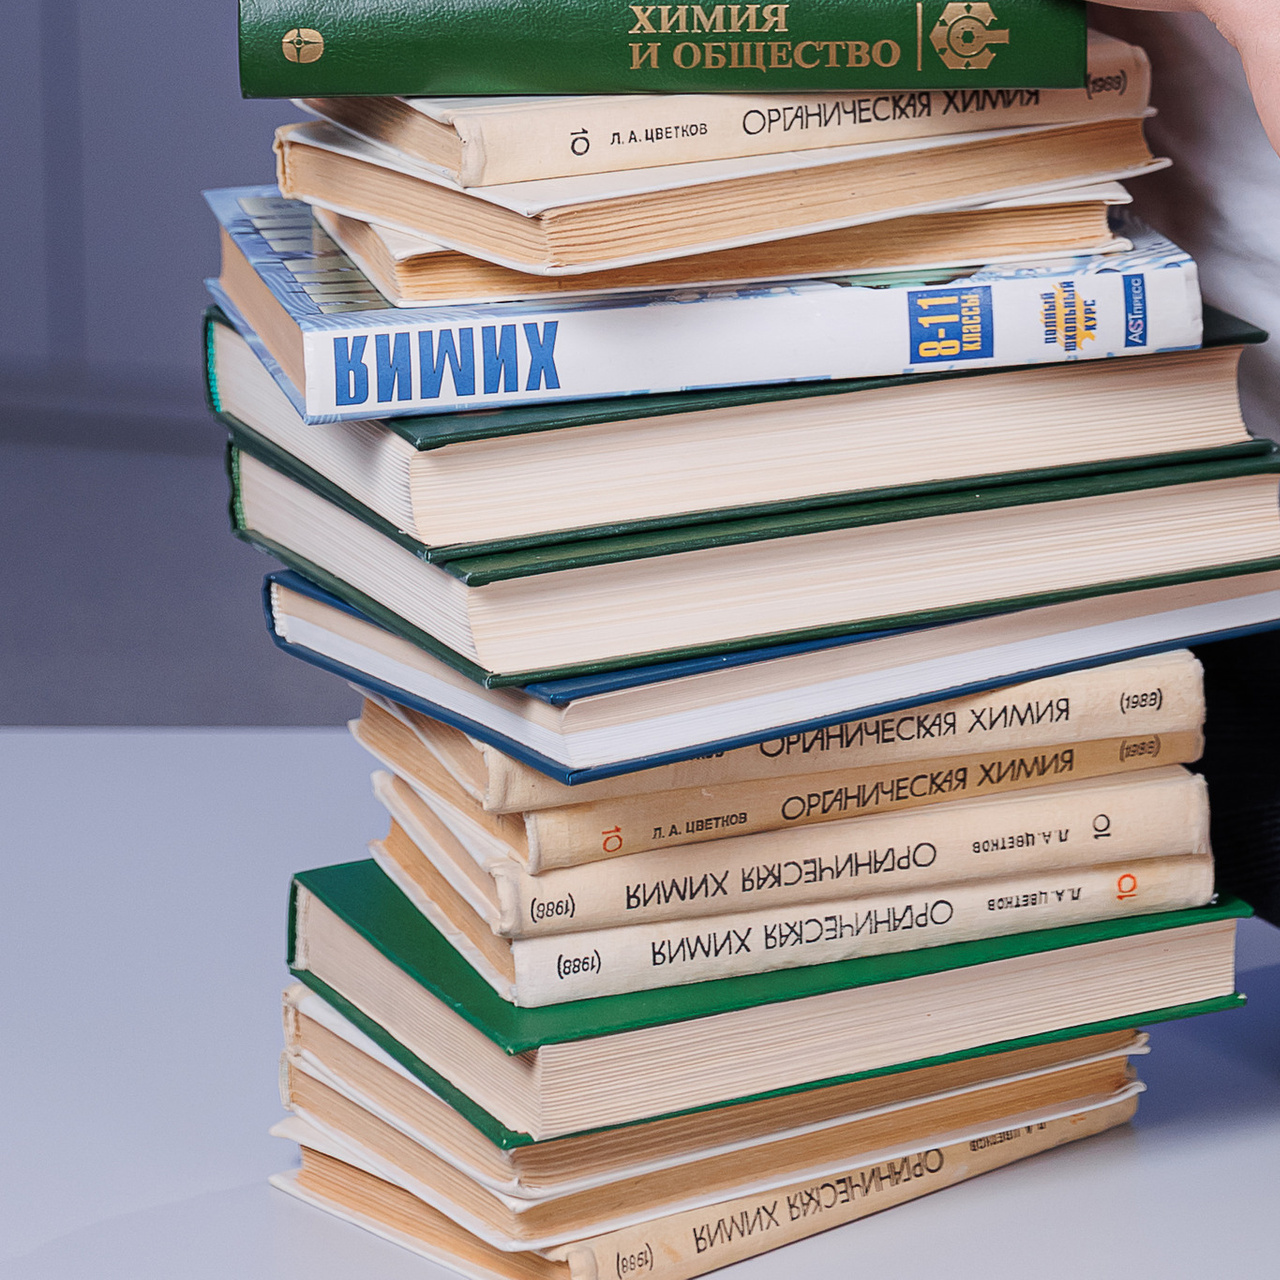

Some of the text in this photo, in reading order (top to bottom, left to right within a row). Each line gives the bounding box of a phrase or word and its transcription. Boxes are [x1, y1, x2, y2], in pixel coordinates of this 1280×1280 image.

[628, 4, 790, 34] ХИМИЯ
[628, 39, 901, 73] И ОБЩЕСТВО
[645, 123, 708, 143] ЦВЕТКОВ
[742, 90, 932, 136] ОРГАНИЧЕСКАЯ
[940, 90, 1040, 116] ХИМИЯ
[917, 295, 960, 358] 8-11
[1039, 292, 1057, 345] ПОЛНЫЙ
[1060, 281, 1077, 352] ШКОЛЬНЫЙ
[1083, 299, 1097, 332] КУРС
[333, 320, 561, 407] ХИМИЯ
[759, 711, 956, 758] ОРГАНИЧЕСКАЯ
[968, 697, 1070, 734] ХИМИЯ
[685, 812, 748, 835] ЦВЕТКОВ
[781, 766, 968, 821] ОРГАНИЧЕСКАЯ
[976, 748, 1075, 787] ХИМИЯ
[741, 842, 937, 892] ОРГАНИЧЕСКАЯ
[972, 832, 1035, 854] ЦВЕТКОВ
[530, 893, 576, 924] (1988)
[625, 870, 729, 910] ХИМИЯ
[987, 891, 1049, 912] ЦВЕТКОВ
[651, 927, 752, 967] ХИМИЯ
[764, 899, 954, 950] ОРГАНИЧЕСКАЯ
[557, 949, 602, 980] (1988)
[786, 1147, 945, 1222] ОРГАНИЧЕСКАЯ
[692, 1200, 781, 1254] ХИМИЯ
